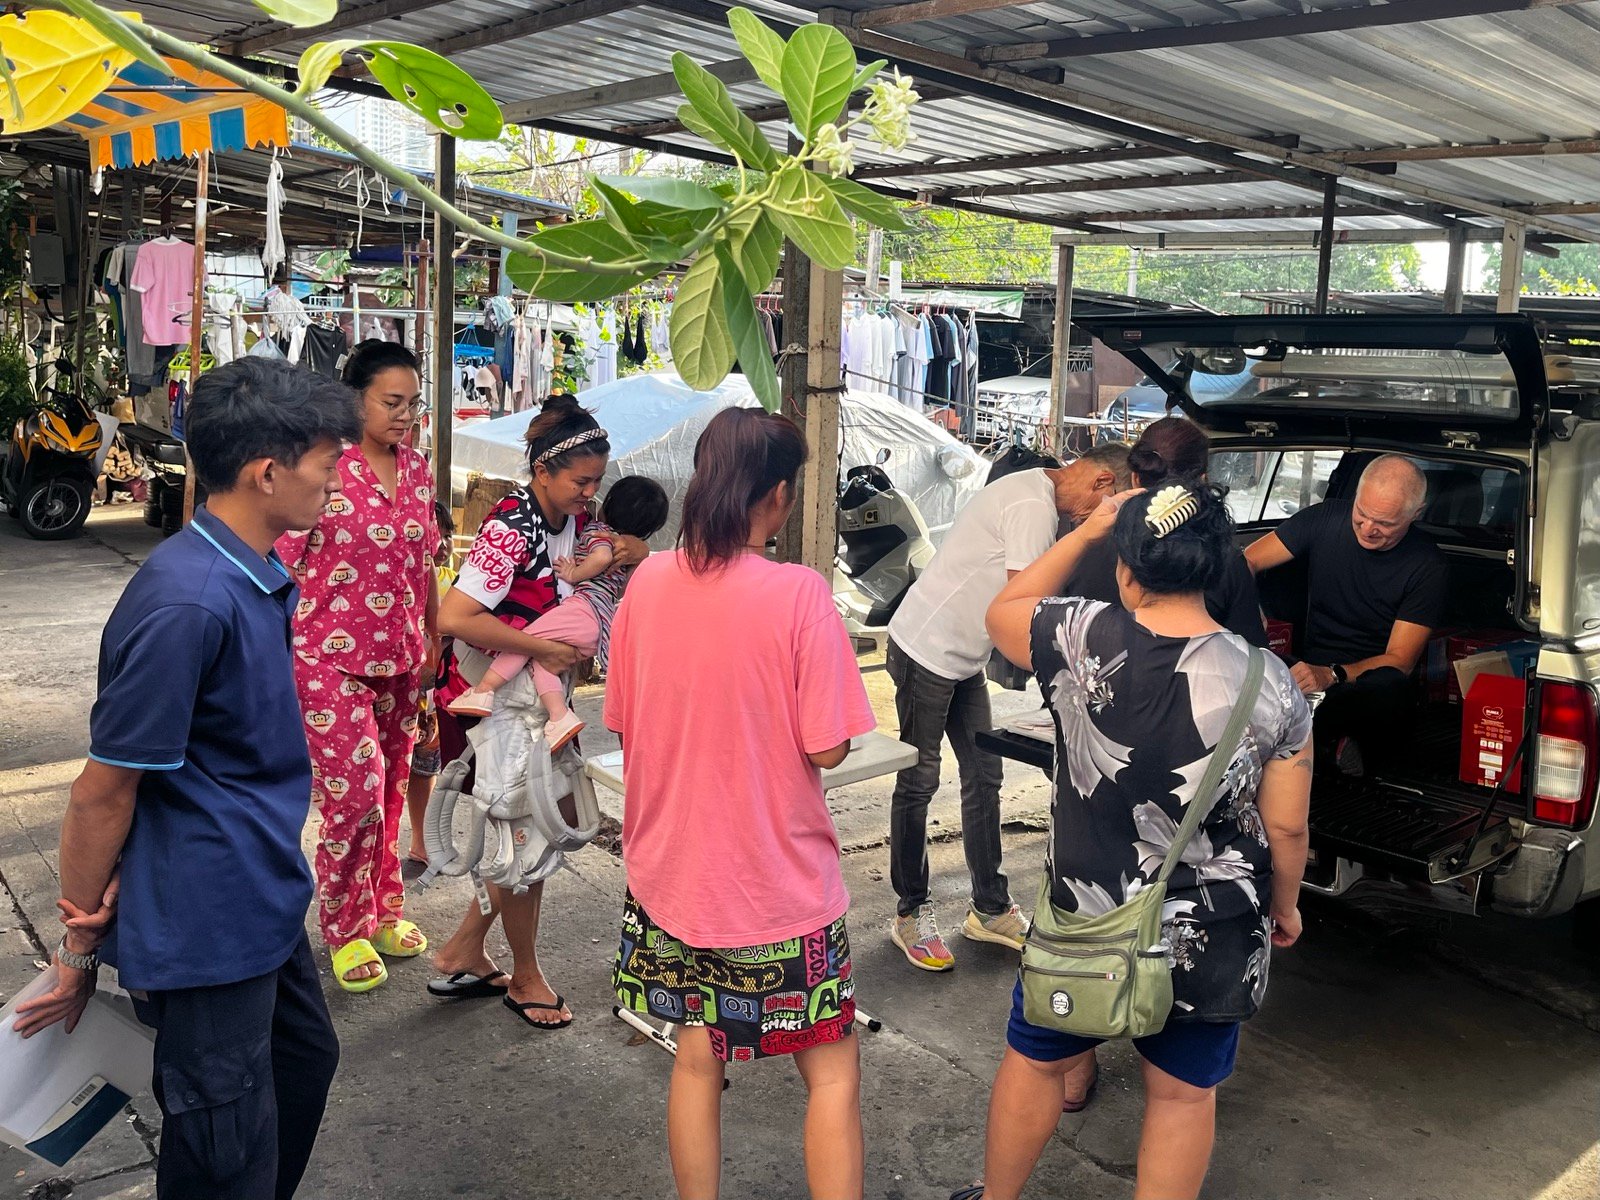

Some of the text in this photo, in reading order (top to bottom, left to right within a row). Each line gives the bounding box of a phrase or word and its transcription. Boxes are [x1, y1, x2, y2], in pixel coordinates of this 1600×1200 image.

[808, 935, 825, 982] 2022
[724, 996, 755, 1020] to
[773, 1011, 795, 1020] CLUB
[761, 1017, 806, 1034] SMART
